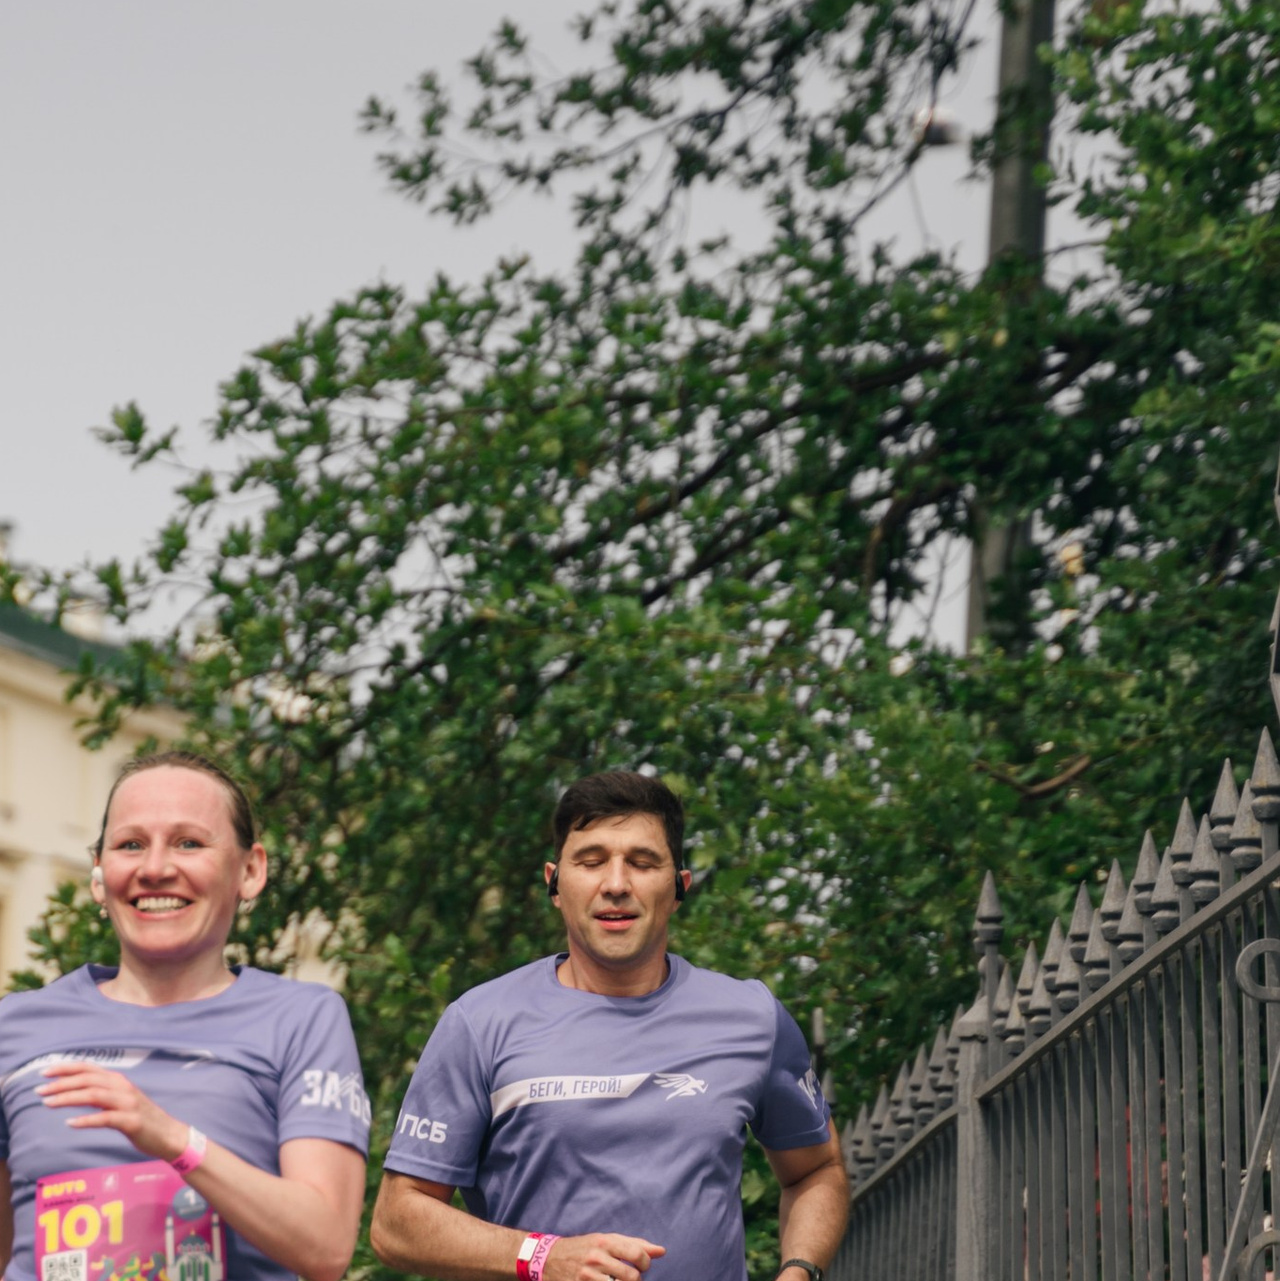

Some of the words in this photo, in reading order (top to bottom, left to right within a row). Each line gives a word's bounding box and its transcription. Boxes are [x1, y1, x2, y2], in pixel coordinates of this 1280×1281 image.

[529, 1081, 567, 1098] БЕГИ,
[573, 1077, 622, 1094] ГЕРОЙ!
[400, 1113, 448, 1144] ПСБ
[184, 1189, 196, 1205] 1
[38, 1200, 124, 1254] 101
